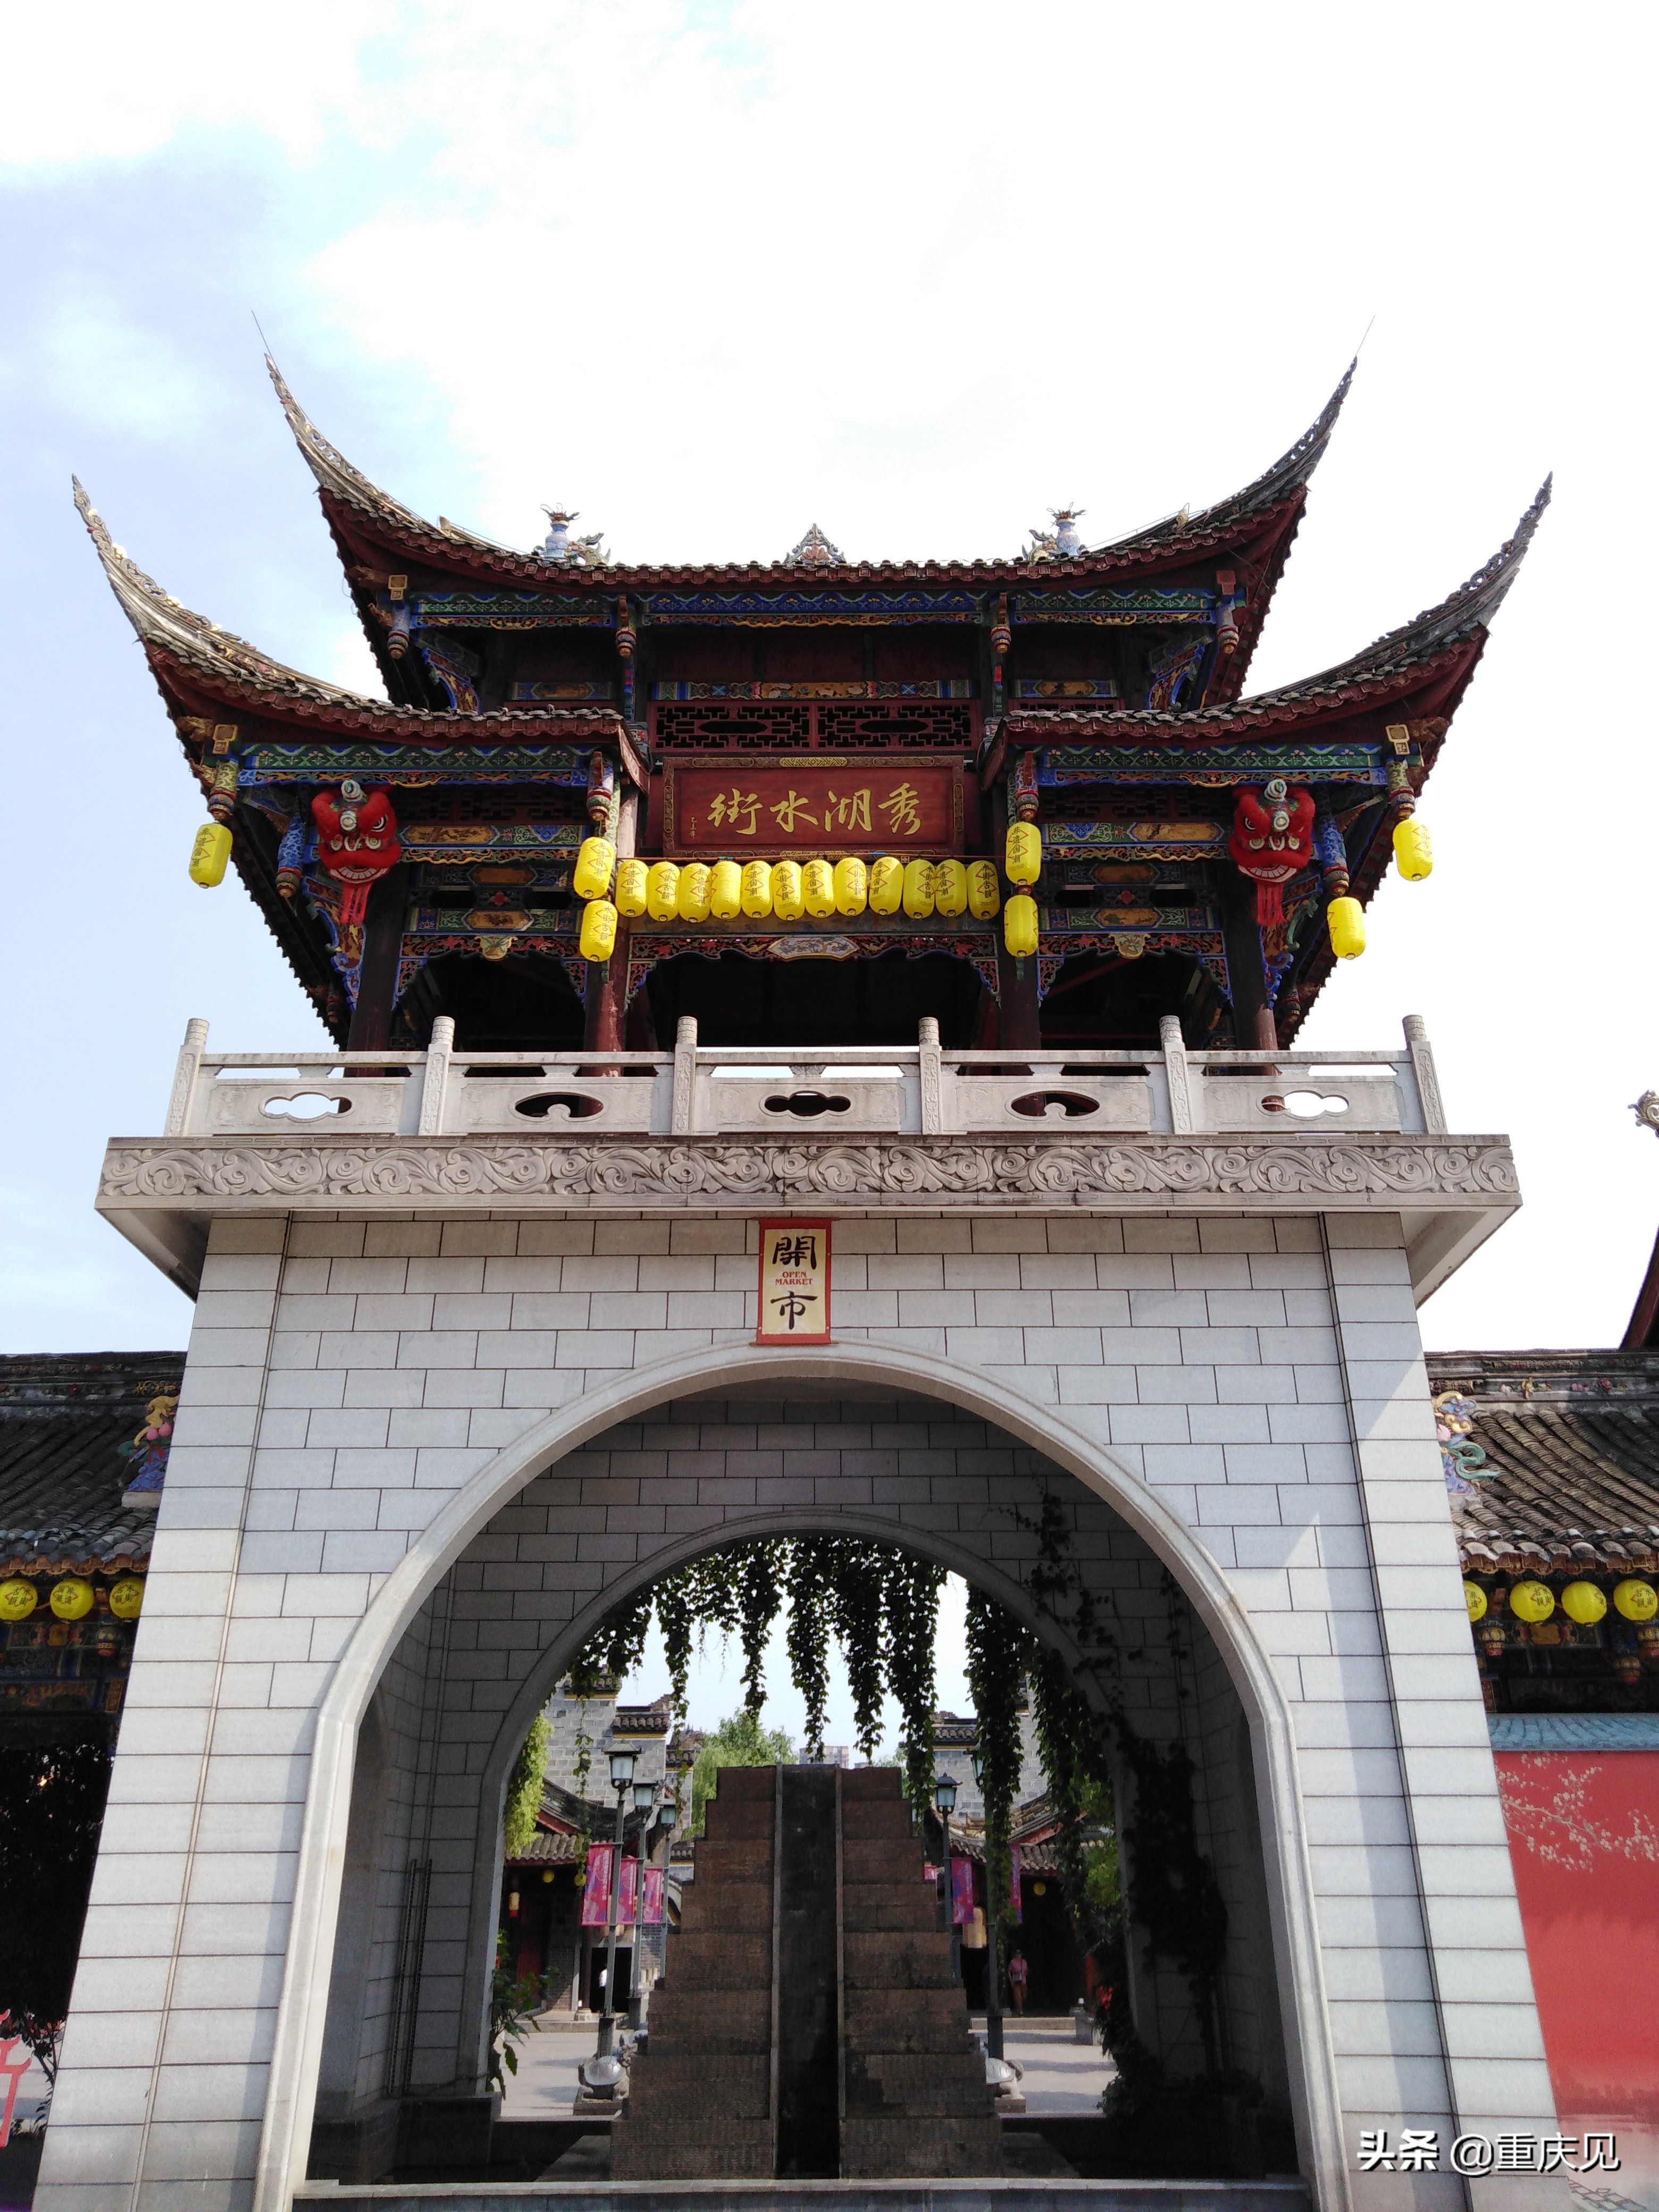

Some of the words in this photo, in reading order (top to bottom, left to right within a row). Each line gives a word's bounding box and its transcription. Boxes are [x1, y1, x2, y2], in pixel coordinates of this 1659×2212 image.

[707, 782, 921, 835] 秀湖水街
[772, 1236, 817, 1270] 開
[770, 1291, 818, 1330] 市
